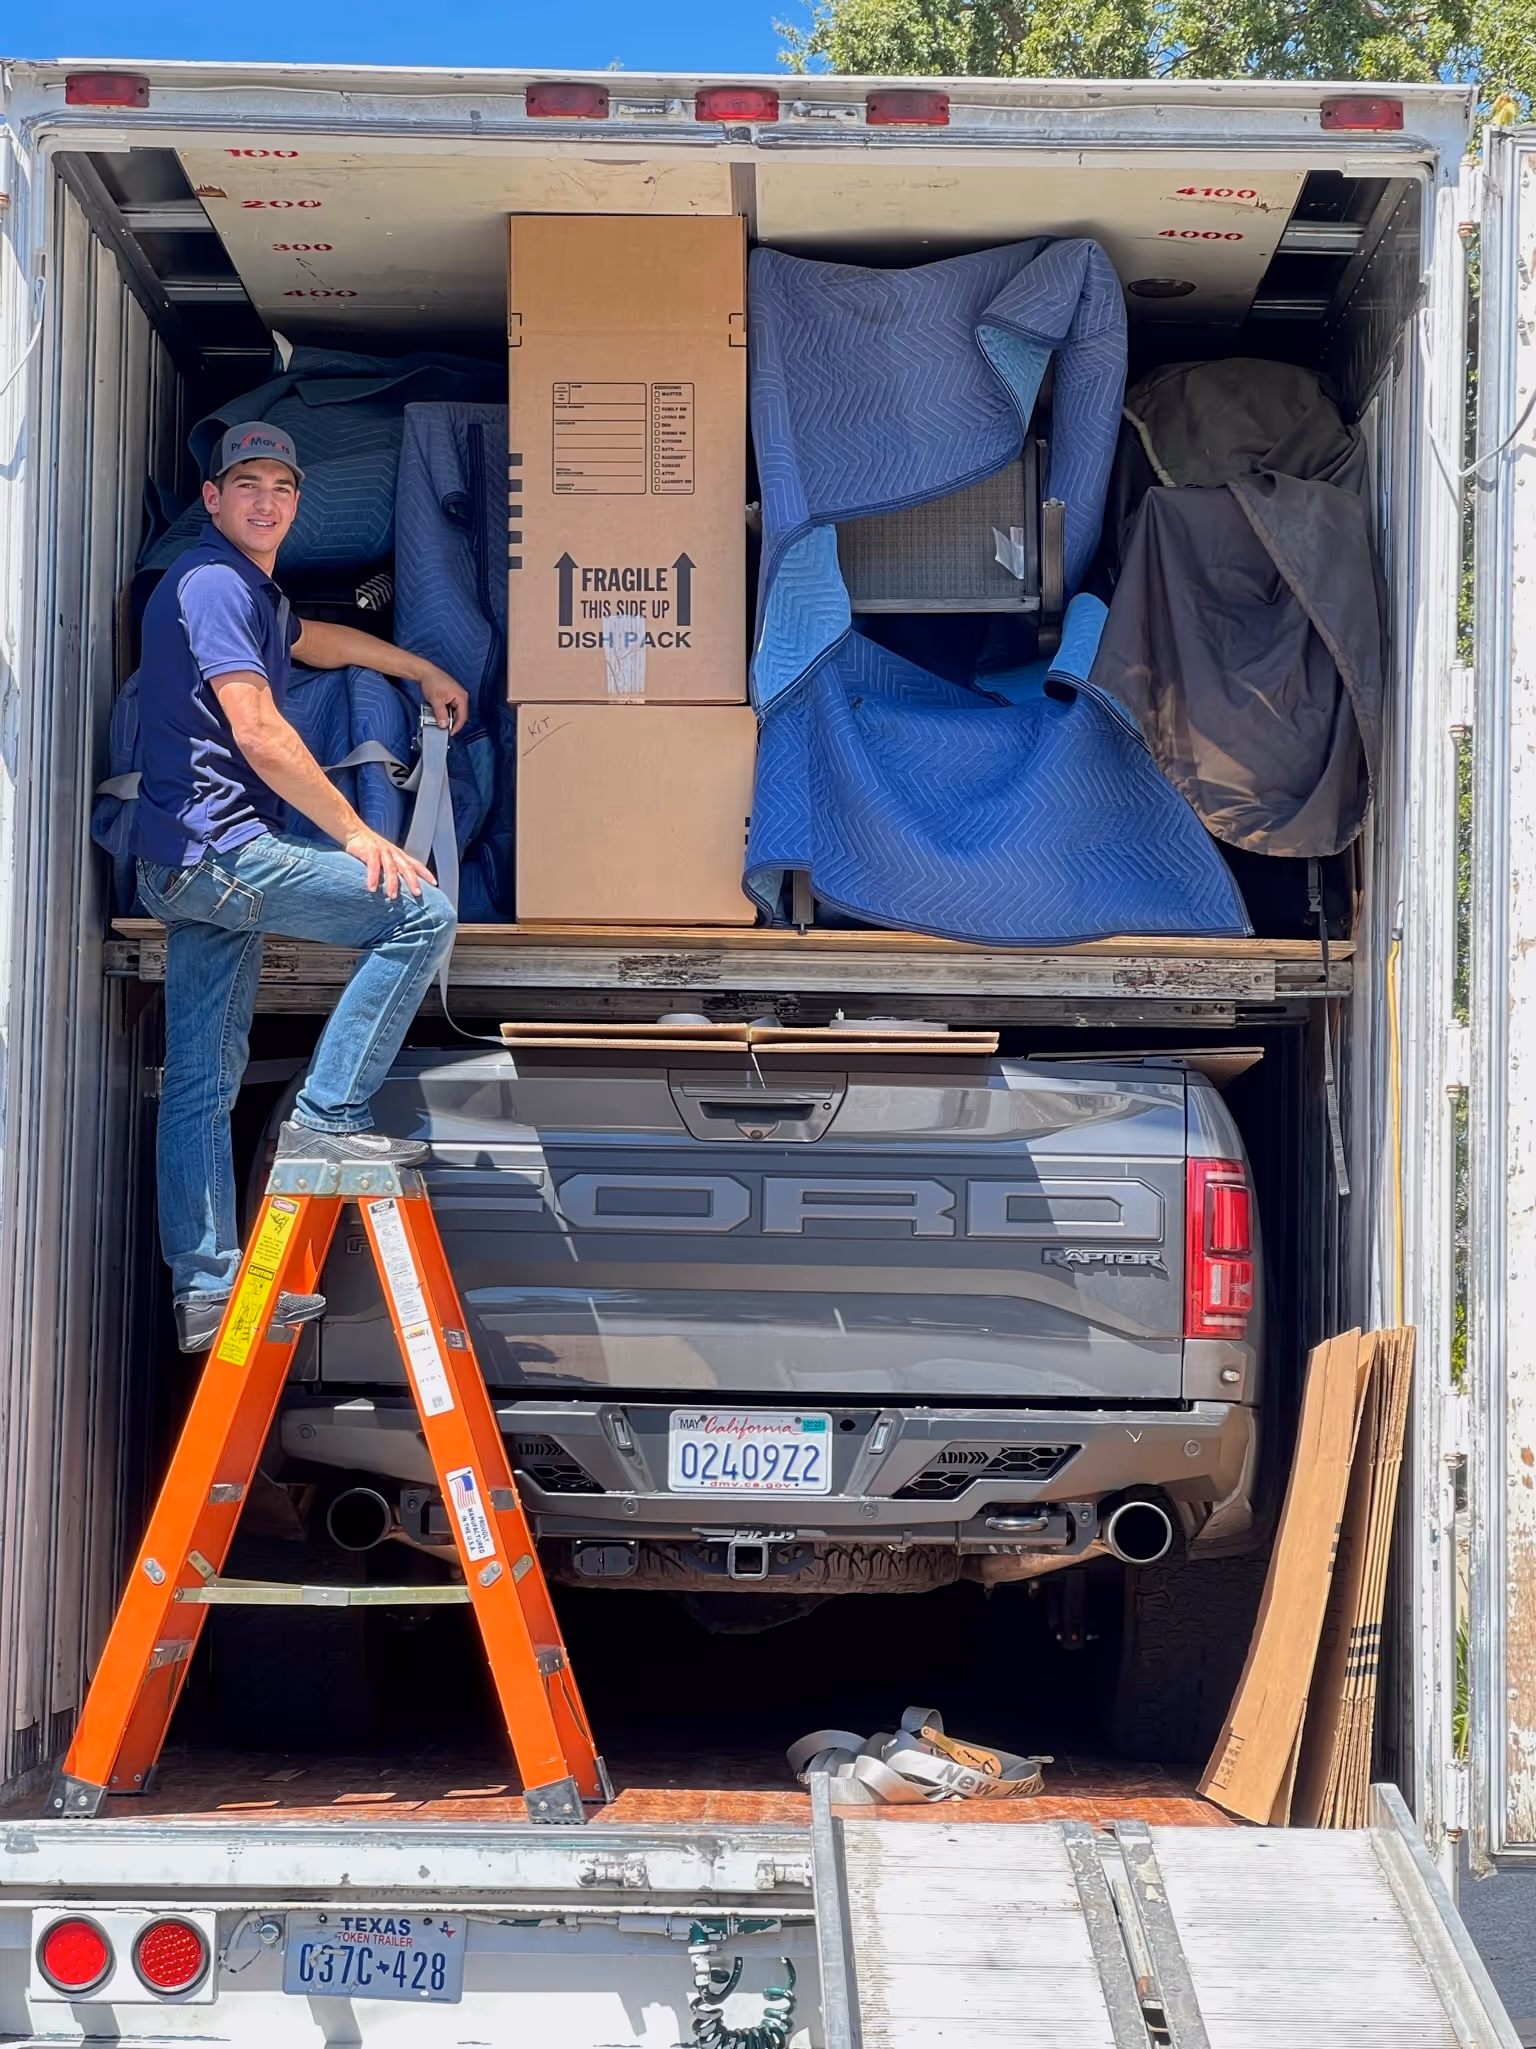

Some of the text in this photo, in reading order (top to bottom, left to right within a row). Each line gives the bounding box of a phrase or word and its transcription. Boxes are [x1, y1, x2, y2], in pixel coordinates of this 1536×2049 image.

[224, 149, 299, 158] 100
[1176, 187, 1257, 199] 4100
[241, 200, 322, 208] 200
[1158, 229, 1244, 241] 4000
[272, 243, 333, 251] 300
[283, 289, 358, 297] 400
[582, 567, 668, 592] FRAGILE
[581, 600, 670, 619] THIS SIDE UP
[558, 631, 692, 648] DISH PACK
[527, 716, 550, 738] KIT
[1041, 1247, 1169, 1274] RAPTOR
[679, 1419, 701, 1429] MAY
[704, 1415, 803, 1440] California
[681, 1442, 820, 1481] 02409Z2
[937, 1451, 969, 1464] ADD
[709, 1481, 791, 1489] dmv.ca.gov
[467, 1507, 485, 1554] MANUFACTURED
[478, 1515, 490, 1542] PROUDLY
[936, 1763, 999, 1796] New
[340, 1917, 411, 1936] TEXAS
[372, 1934, 413, 1948] TRAILER
